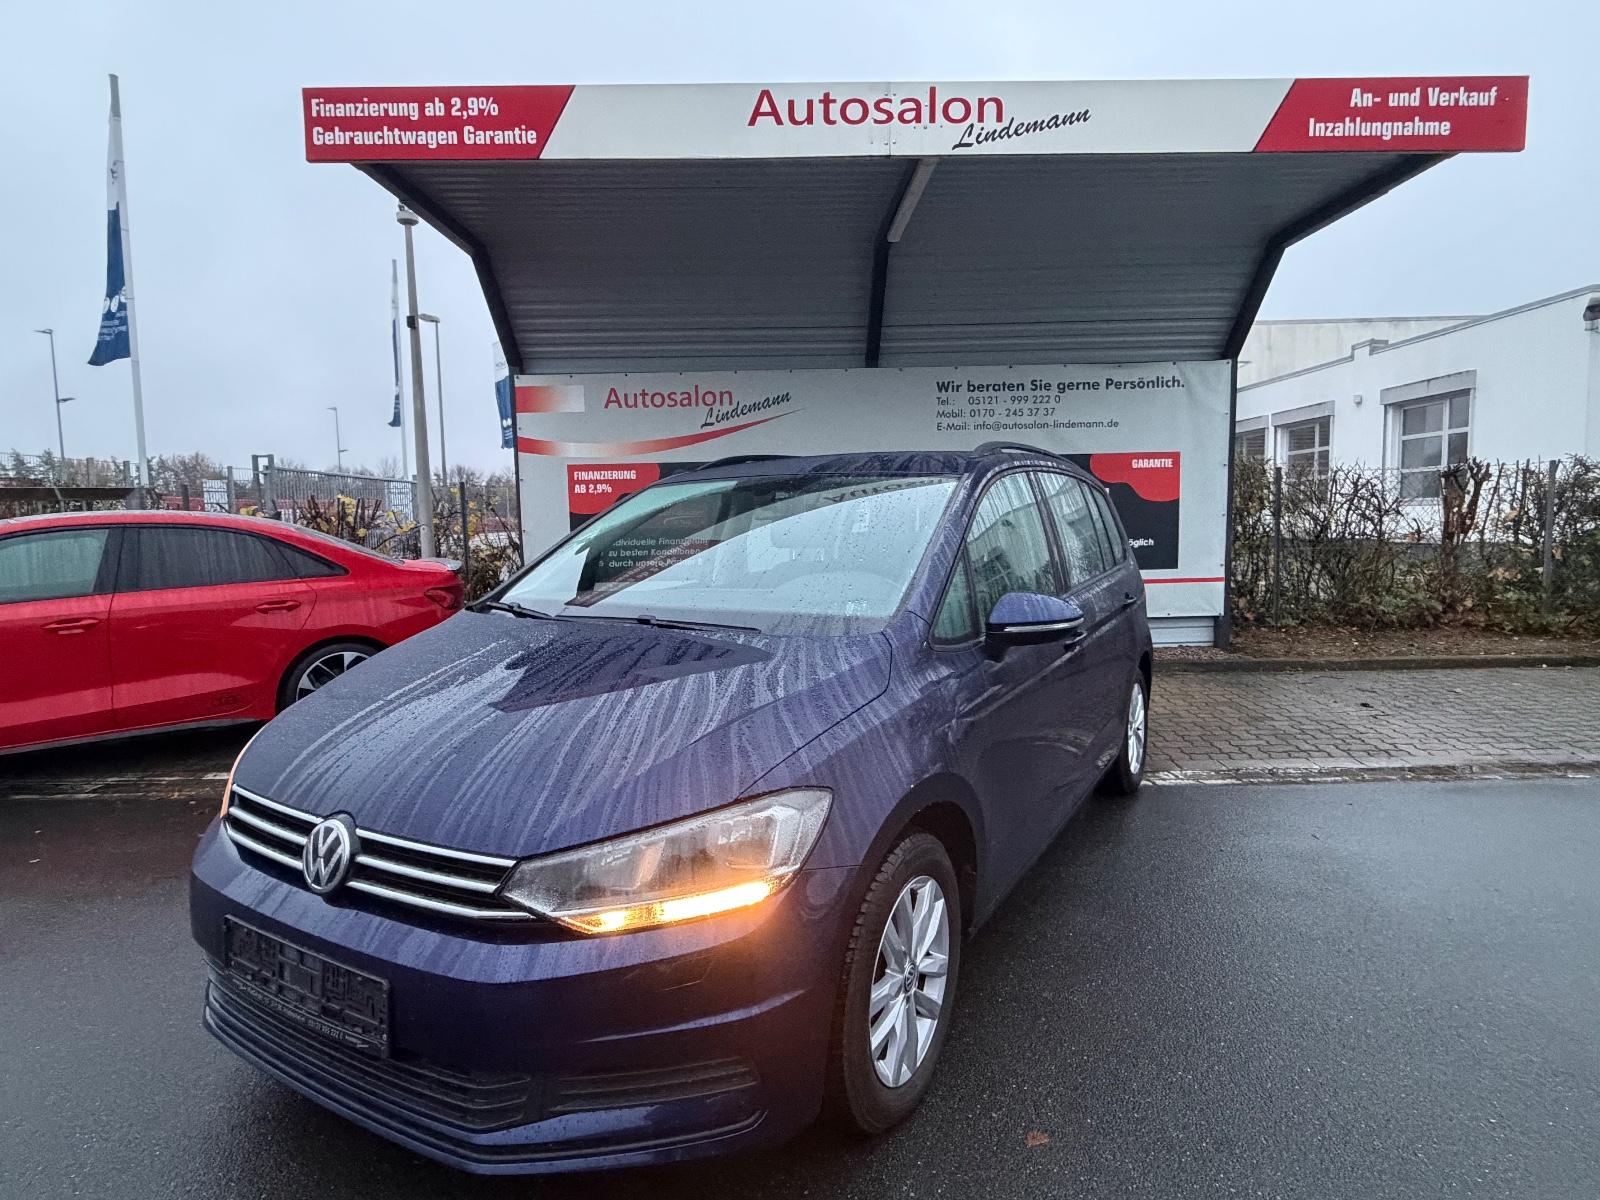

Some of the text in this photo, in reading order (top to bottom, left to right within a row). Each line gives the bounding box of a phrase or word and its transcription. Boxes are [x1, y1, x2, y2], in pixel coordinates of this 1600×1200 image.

[1350, 86, 1498, 107] An- und Verkauf
[311, 96, 499, 120] Finanzierung ab 2,9%
[748, 86, 1004, 126] Autosalon
[951, 108, 1092, 150] Lindemann
[1308, 116, 1451, 140] Inzahlungnahme
[312, 125, 537, 148] Gebrauchtwagen Garantie
[936, 375, 1185, 393] Wir beraten Sie gerne Persönlich.
[603, 384, 734, 409] Autosalon
[936, 397, 956, 406] Tel.:
[967, 395, 999, 406] 05121
[1010, 395, 1029, 405] 999
[1032, 394, 1051, 405] 222
[1054, 394, 1061, 404] 0
[701, 390, 792, 429] Lindemann
[936, 409, 966, 419] Mobil:
[969, 408, 995, 418] 0170
[1004, 408, 1024, 418] 245
[1027, 407, 1040, 417] 37
[1043, 407, 1056, 417] 37
[936, 419, 1119, 431] E-Mail: info@autosalon-lindemann.de
[1131, 458, 1174, 469] GARANTIE
[573, 469, 637, 481] FINANZIERUNG
[574, 483, 613, 494] AB 2,9%
[613, 538, 656, 546] dividuelle
[1128, 538, 1155, 548] öglich
[620, 548, 648, 557] besten
[609, 559, 633, 567] durch
